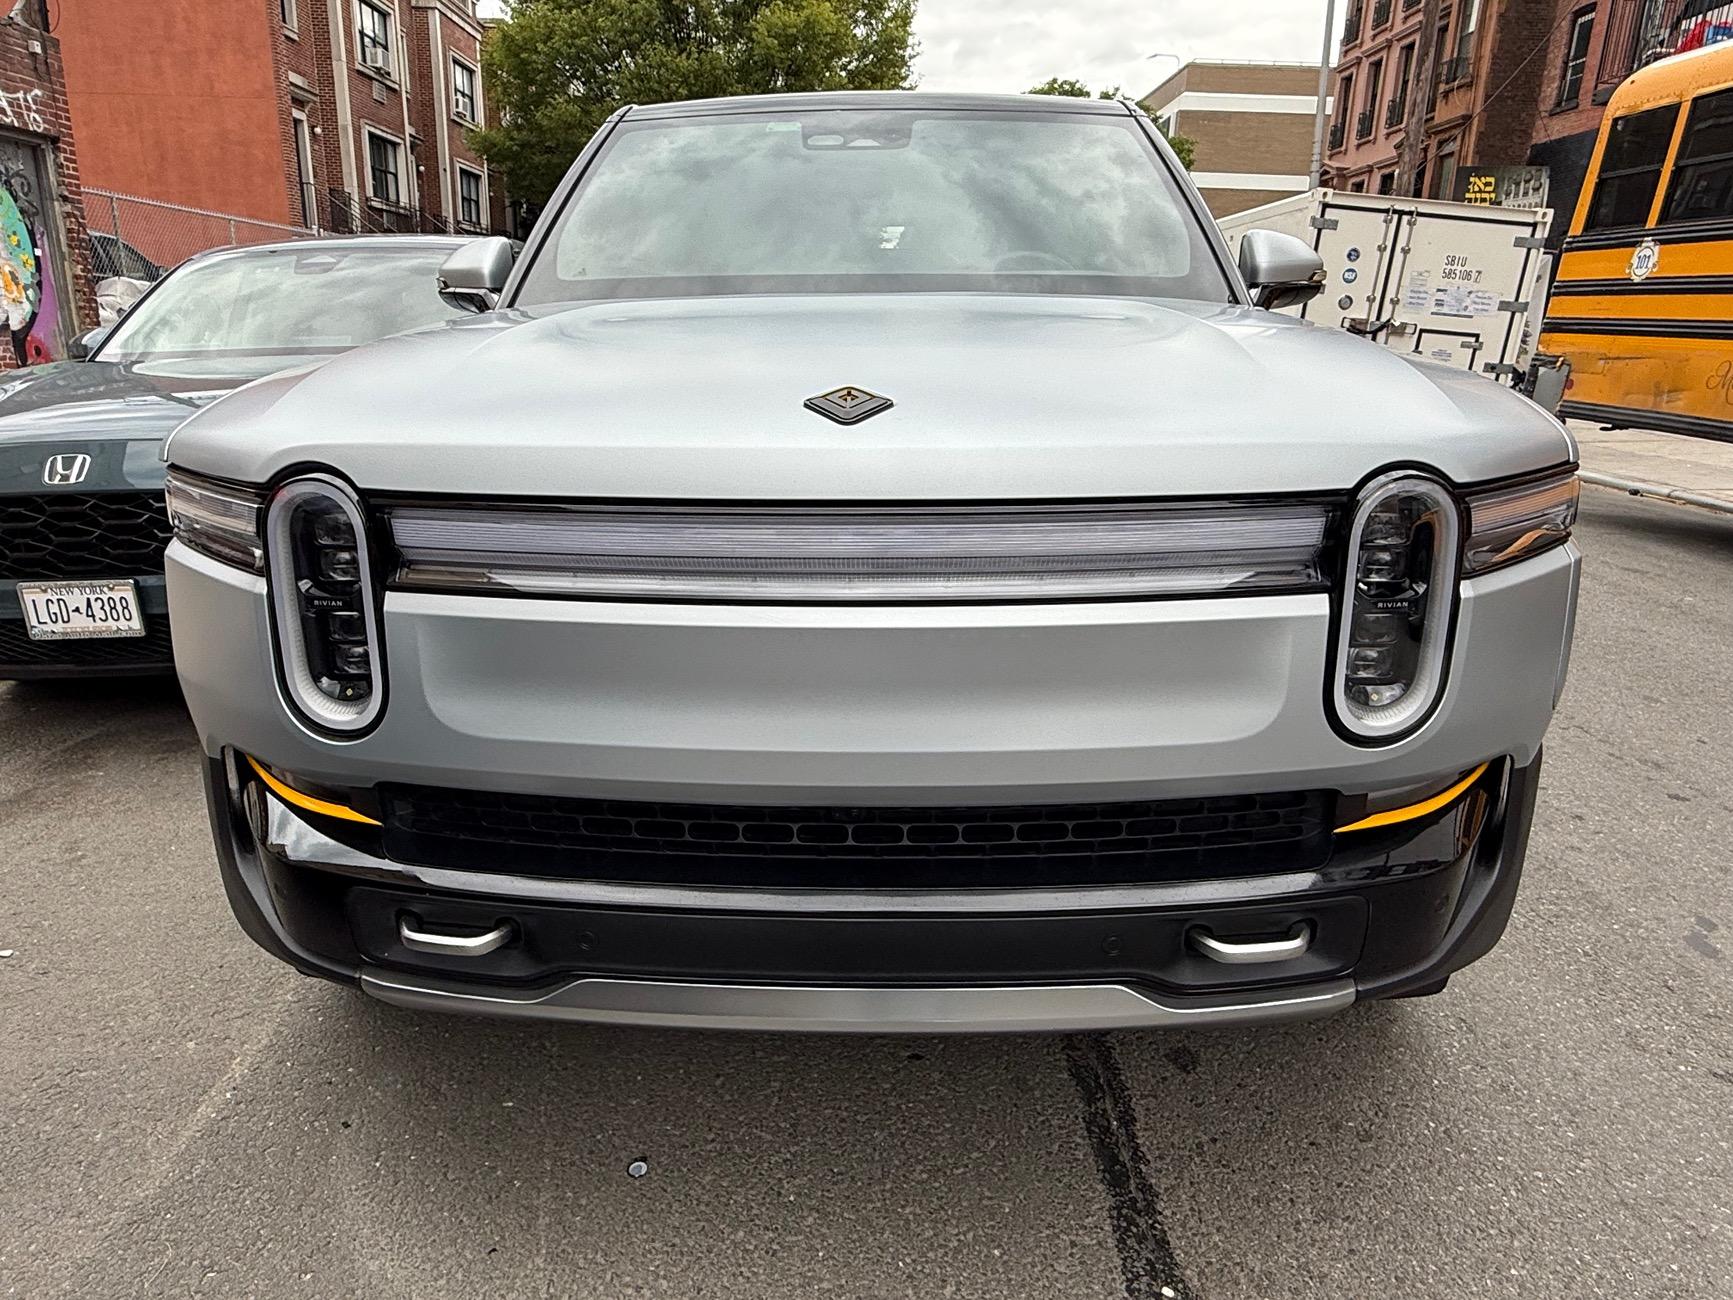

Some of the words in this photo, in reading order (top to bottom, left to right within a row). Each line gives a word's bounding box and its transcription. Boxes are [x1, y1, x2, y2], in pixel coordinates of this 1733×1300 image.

[1445, 255, 1468, 267] SBIU
[1635, 254, 1652, 270] 101
[50, 587, 75, 597] NEW
[79, 585, 107, 596] YORK
